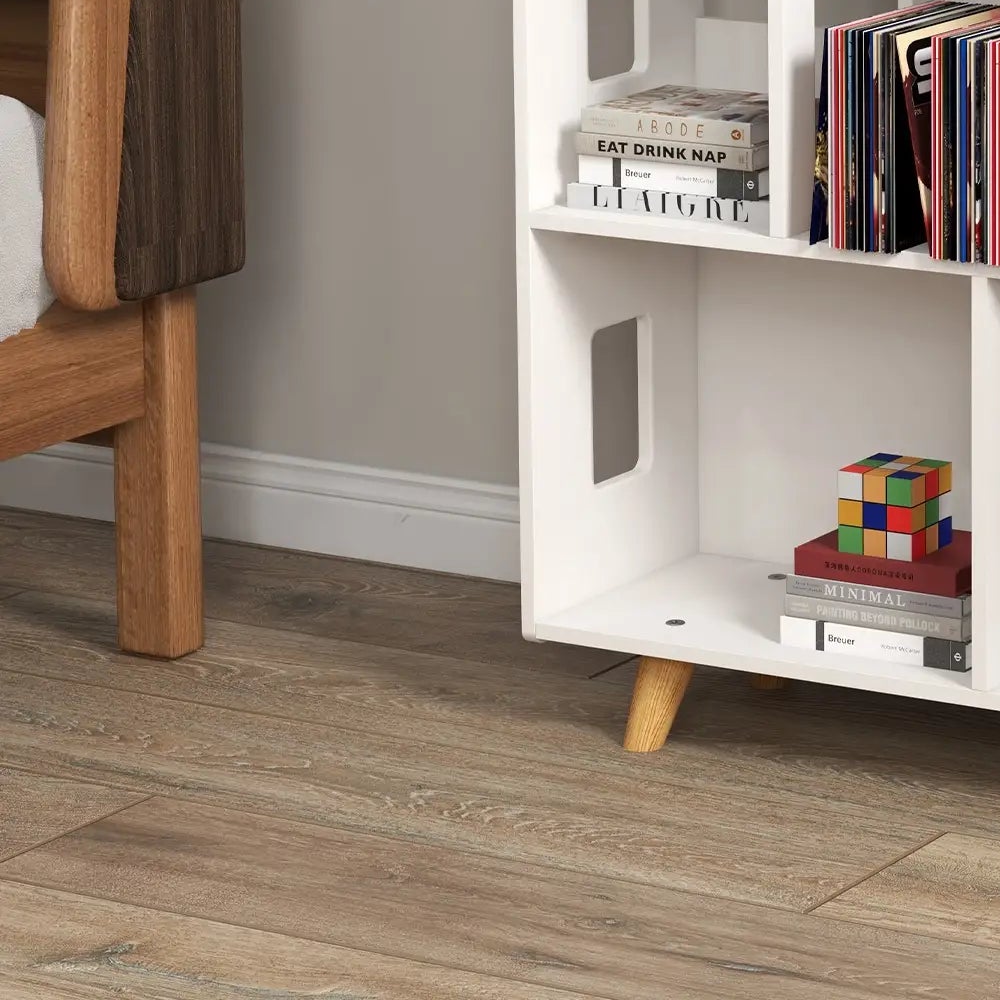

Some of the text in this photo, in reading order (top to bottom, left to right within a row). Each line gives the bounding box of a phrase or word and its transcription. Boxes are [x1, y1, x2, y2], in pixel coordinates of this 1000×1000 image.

[637, 119, 705, 138] ABODE
[598, 140, 628, 153] EAT
[634, 143, 687, 160] DRINK
[692, 148, 727, 164] NAP
[625, 169, 651, 179] Breuer
[593, 185, 749, 222] LIAIGRE
[824, 583, 906, 606] MINIMAL
[816, 605, 858, 621] PAINTING
[860, 610, 896, 625] BEYOND
[899, 617, 940, 633] POLLOCK
[828, 634, 855, 645] Breuer
